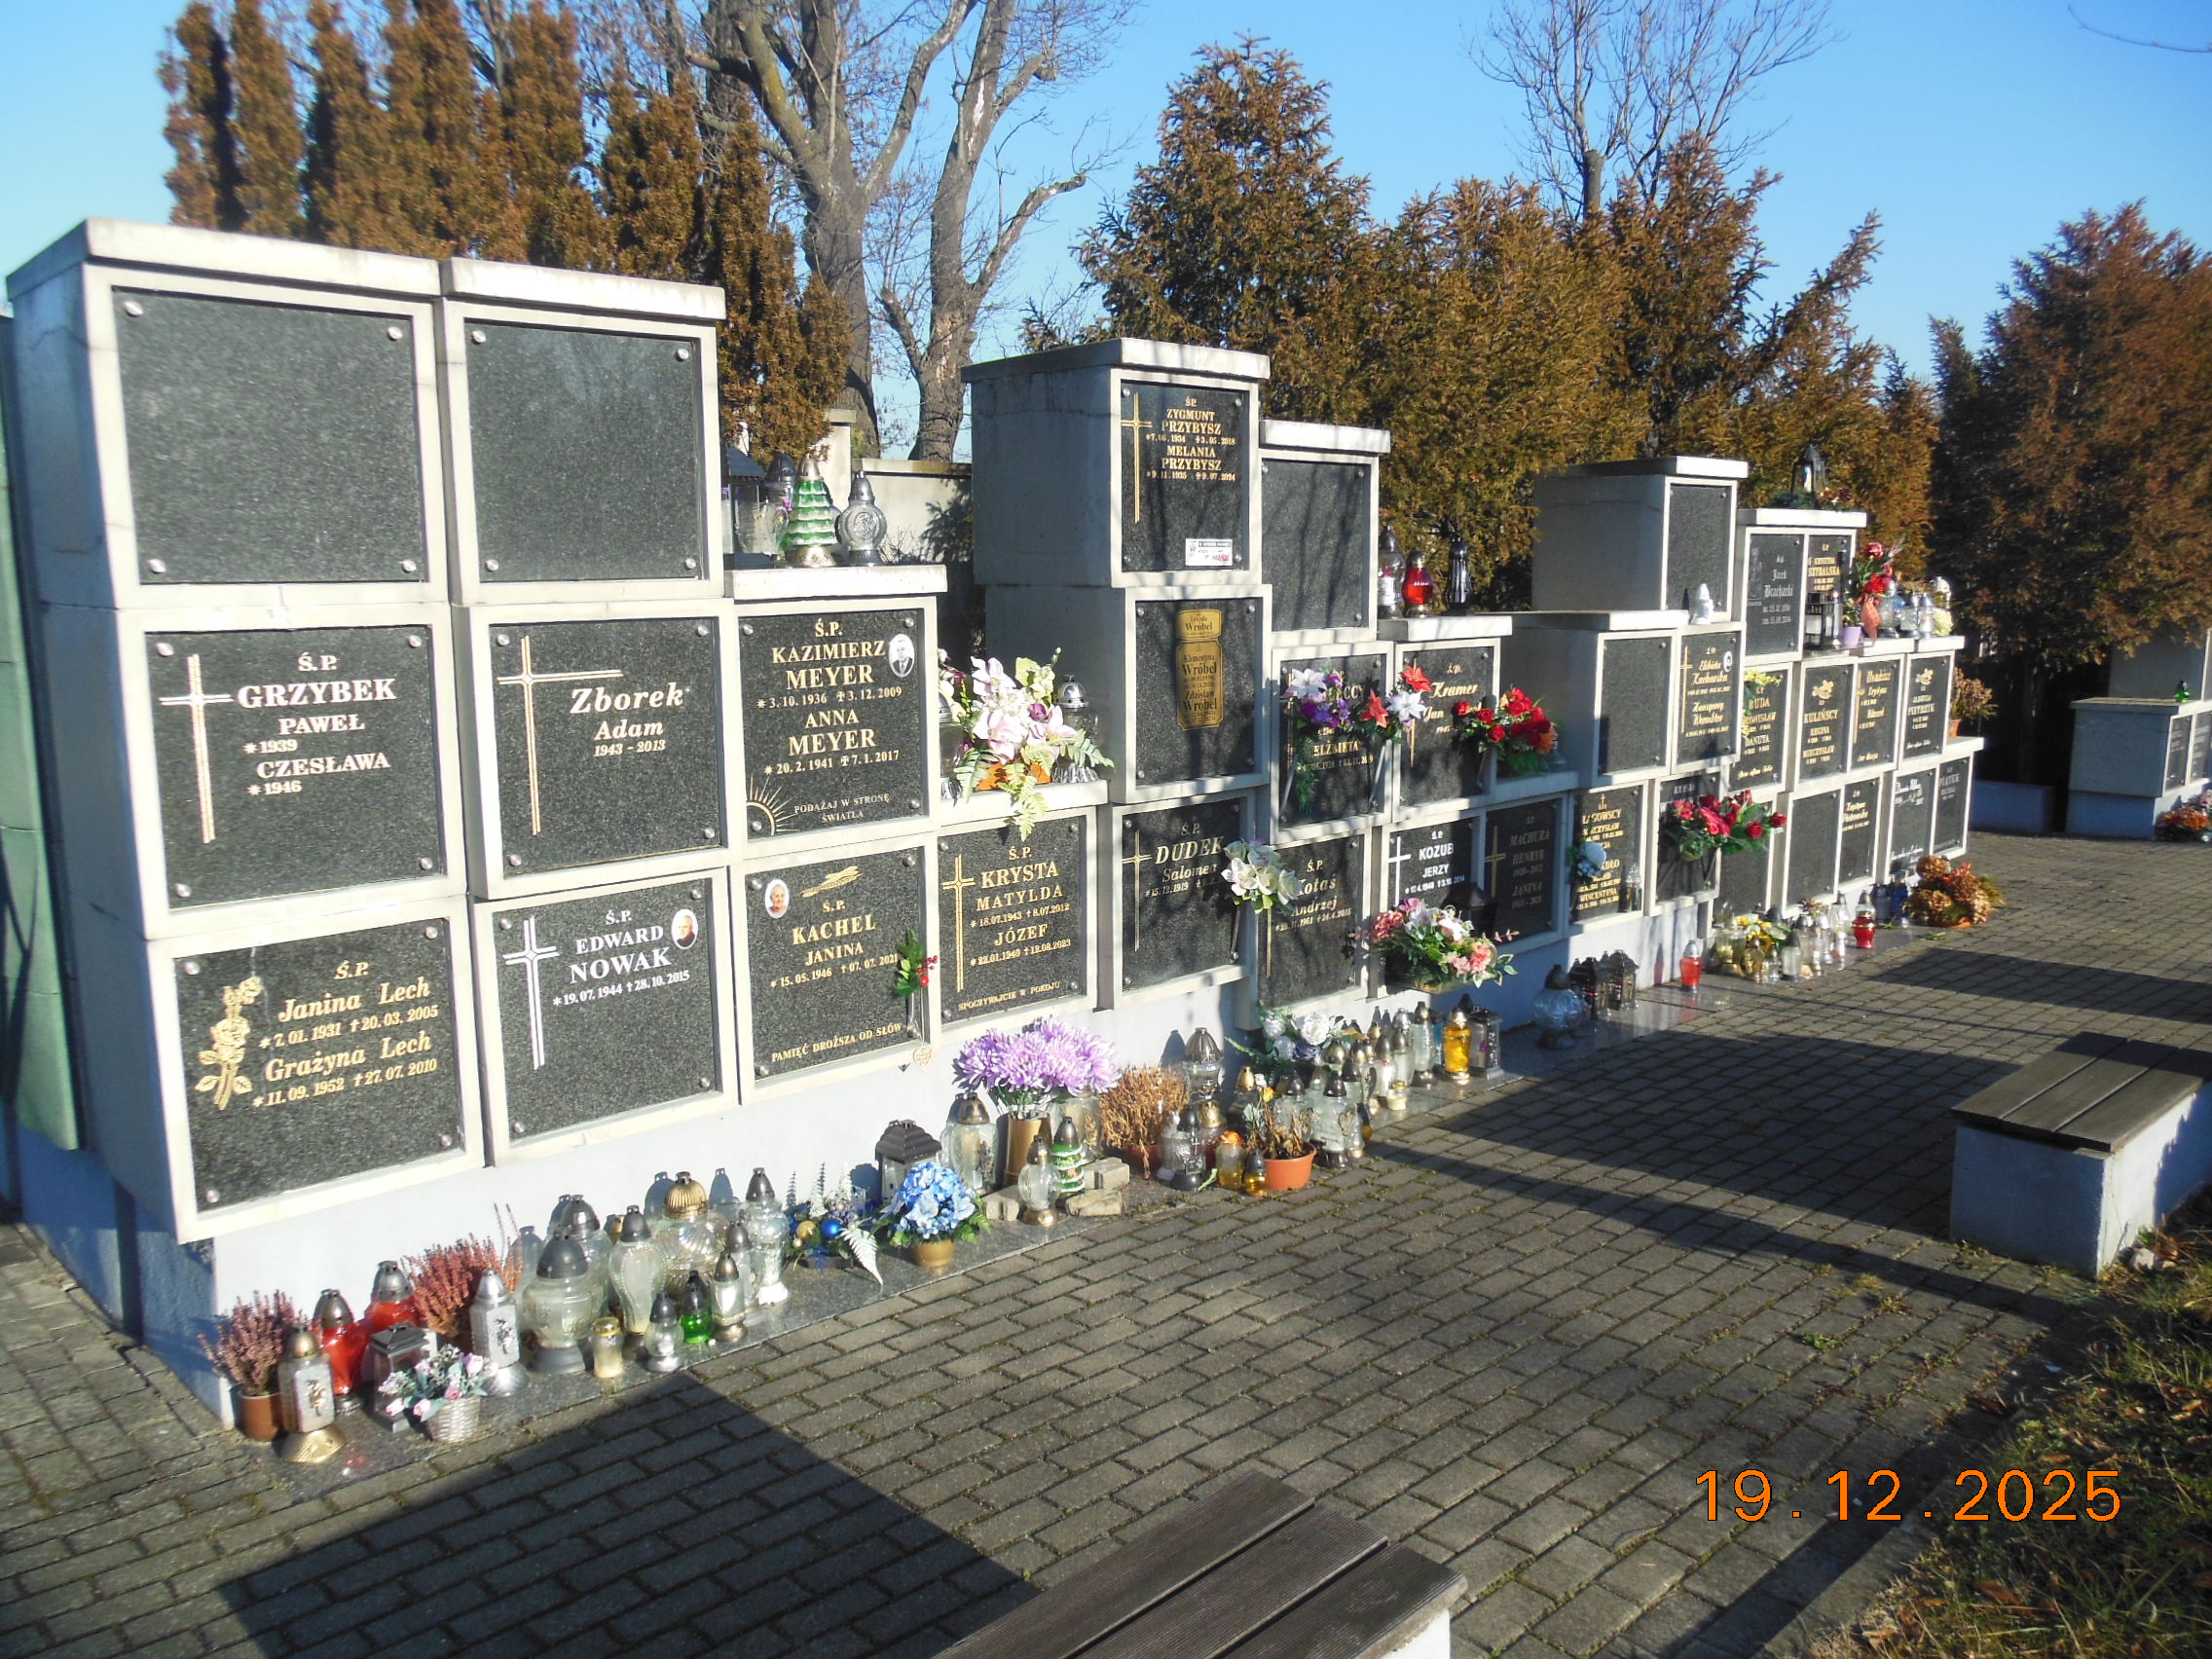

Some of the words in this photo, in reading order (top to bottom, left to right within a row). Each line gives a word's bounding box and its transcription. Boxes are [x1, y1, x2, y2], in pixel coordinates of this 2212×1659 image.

[1167, 409, 1215, 422] ZYGMUNT
[1161, 421, 1221, 435] PRZYBYSZ
[1166, 445, 1216, 458] MELANIA
[1161, 458, 1222, 471] PRZYBYSZ
[1185, 621, 1213, 631] Wróbel
[772, 641, 886, 663] KAZIMIERZ
[787, 664, 874, 689] MEYER
[1183, 662, 1217, 676] Wróbel
[237, 679, 396, 709] GRZYBEK
[570, 682, 683, 715] Zborek
[1430, 682, 1478, 698] Kramer
[1183, 698, 1217, 711] Wróbel
[1423, 707, 1445, 722] Jan
[279, 714, 365, 735] PAWEŁ
[805, 709, 859, 728] ANNA
[594, 719, 664, 740] Adam
[593, 744, 623, 756] 1943
[637, 740, 665, 753] 2013
[789, 728, 876, 756] MEYER
[256, 752, 391, 779] CZESŁAWA
[841, 797, 851, 807] W
[1156, 835, 1225, 865] DUDEK
[1419, 842, 1455, 862] KOZUB
[981, 861, 1059, 889] KRYSTA
[1161, 864, 1217, 883] Salomea
[1422, 864, 1450, 878] JERZY
[977, 885, 1063, 911] MATYLDA
[1290, 896, 1338, 917] Andrzej
[792, 913, 876, 945] KACHEL
[994, 924, 1049, 946] JÓZEF
[575, 926, 664, 955] EDWARD
[805, 942, 865, 966] JANINA
[570, 947, 672, 984] NOWAK
[277, 993, 361, 1022] Janina
[378, 976, 430, 1006] Lech
[958, 992, 1016, 1012] SPOCZYWAJCIE
[1030, 981, 1060, 994] POKOJU
[771, 1046, 809, 1063] PAMIĘĆ
[813, 1035, 856, 1052] DROŻSZA
[860, 1030, 873, 1042] OD
[876, 1022, 903, 1037] SŁÓW
[265, 1048, 366, 1082] Grażyna
[380, 1030, 431, 1059] Lech
